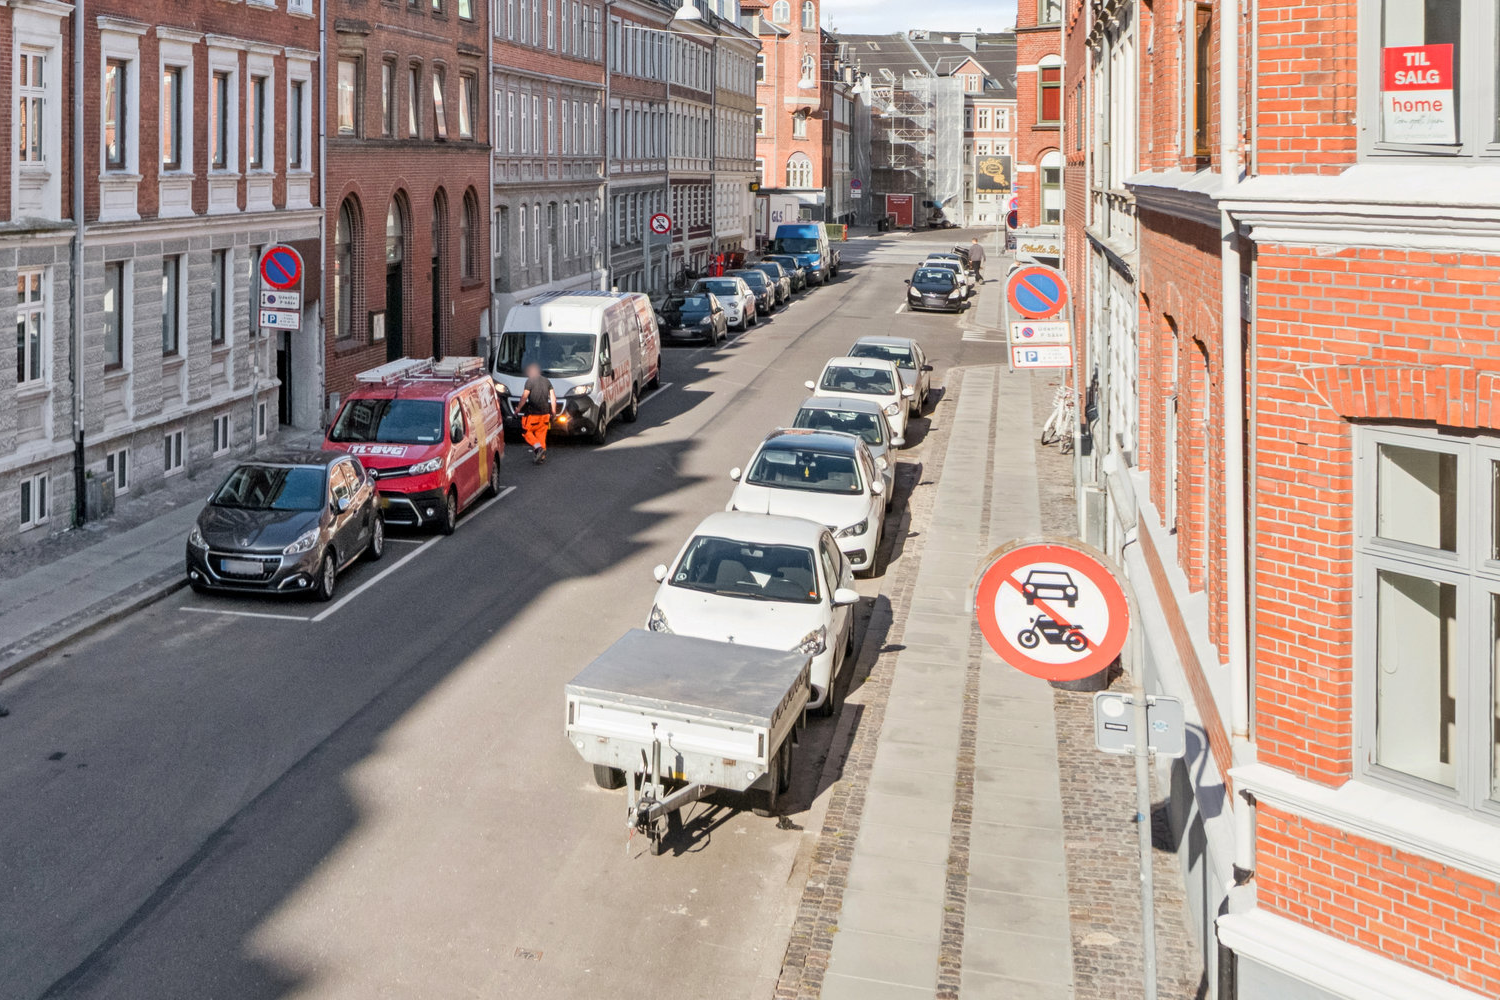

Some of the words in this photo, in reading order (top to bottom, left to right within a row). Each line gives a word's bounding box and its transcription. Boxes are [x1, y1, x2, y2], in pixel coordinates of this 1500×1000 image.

[1403, 51, 1430, 66] TIL
[1394, 69, 1440, 85] SALG
[1392, 96, 1443, 113] home
[772, 210, 783, 223] GLS
